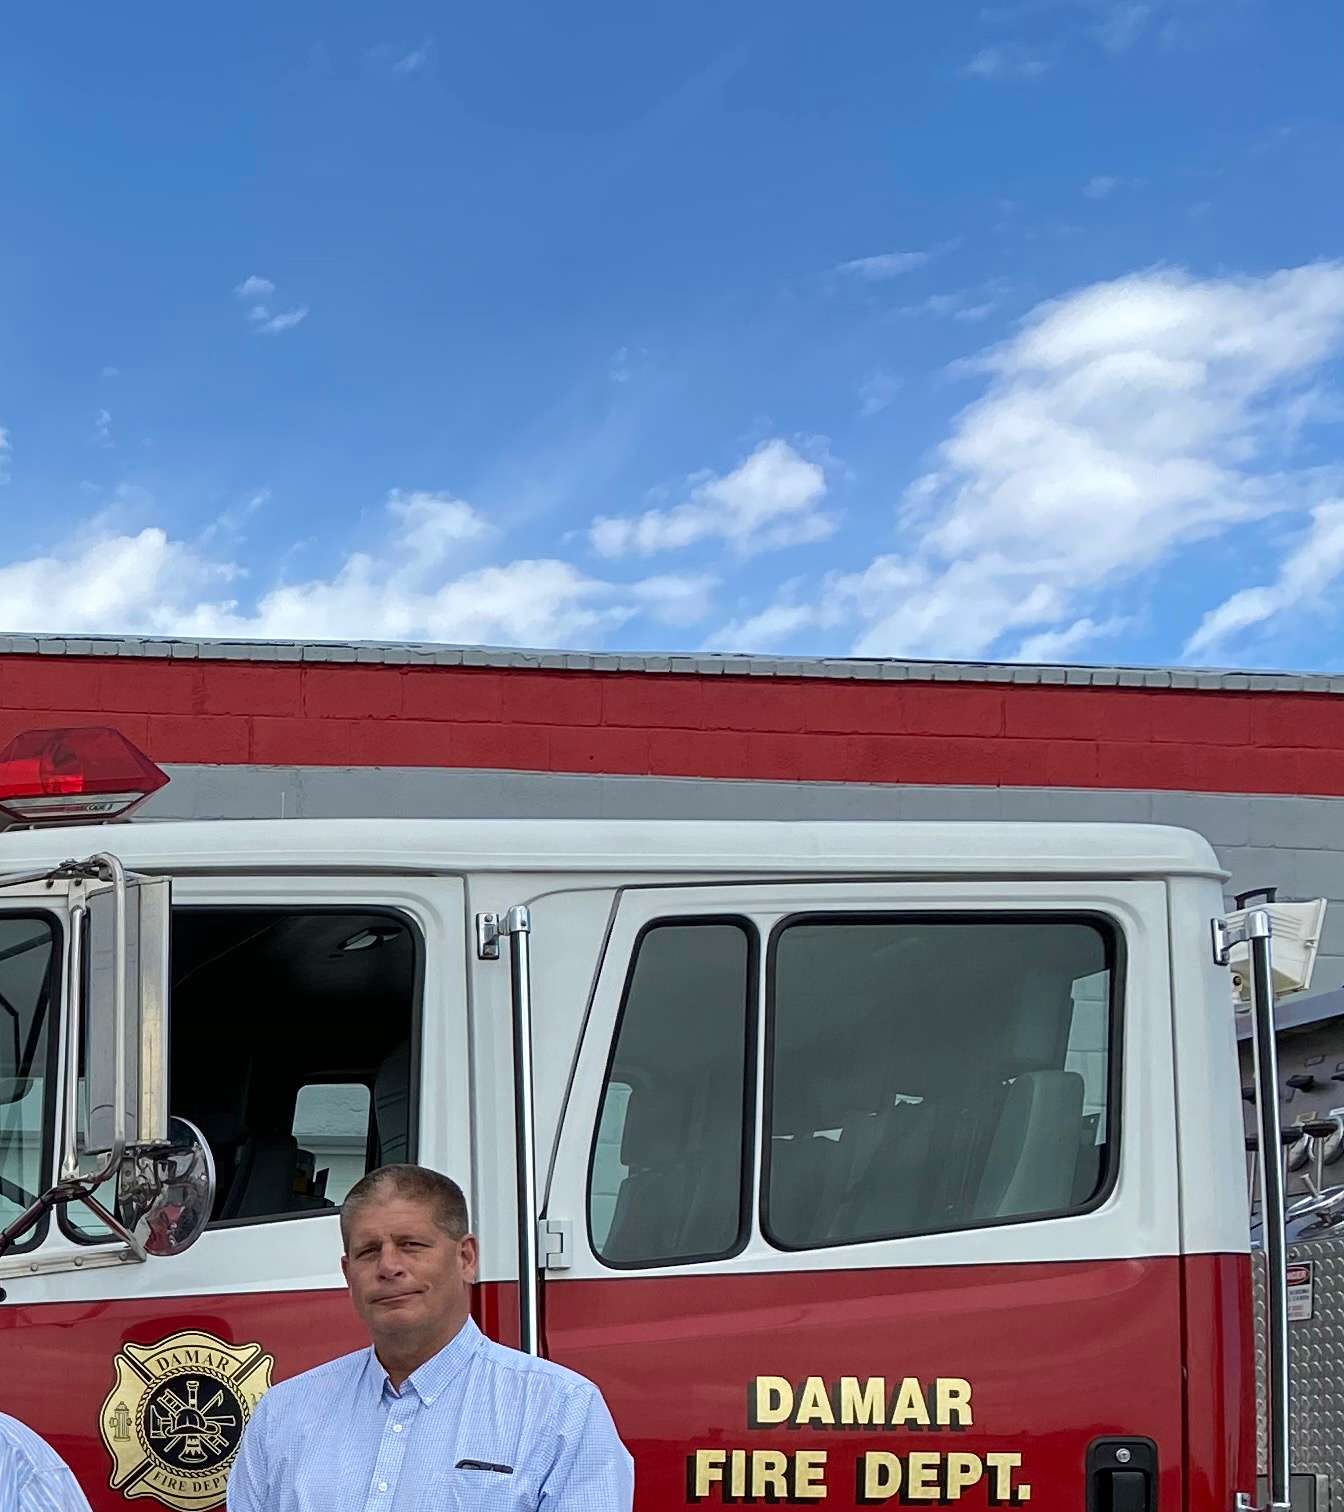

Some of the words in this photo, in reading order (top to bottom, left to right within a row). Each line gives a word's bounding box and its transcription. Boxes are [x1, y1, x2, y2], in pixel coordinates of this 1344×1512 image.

[154, 1350, 230, 1372] DAMAR
[756, 1375, 973, 1425] DAMAR
[153, 1469, 185, 1491] FIRE
[695, 1449, 828, 1498] FIRE
[864, 1450, 1031, 1500] DEPT.
